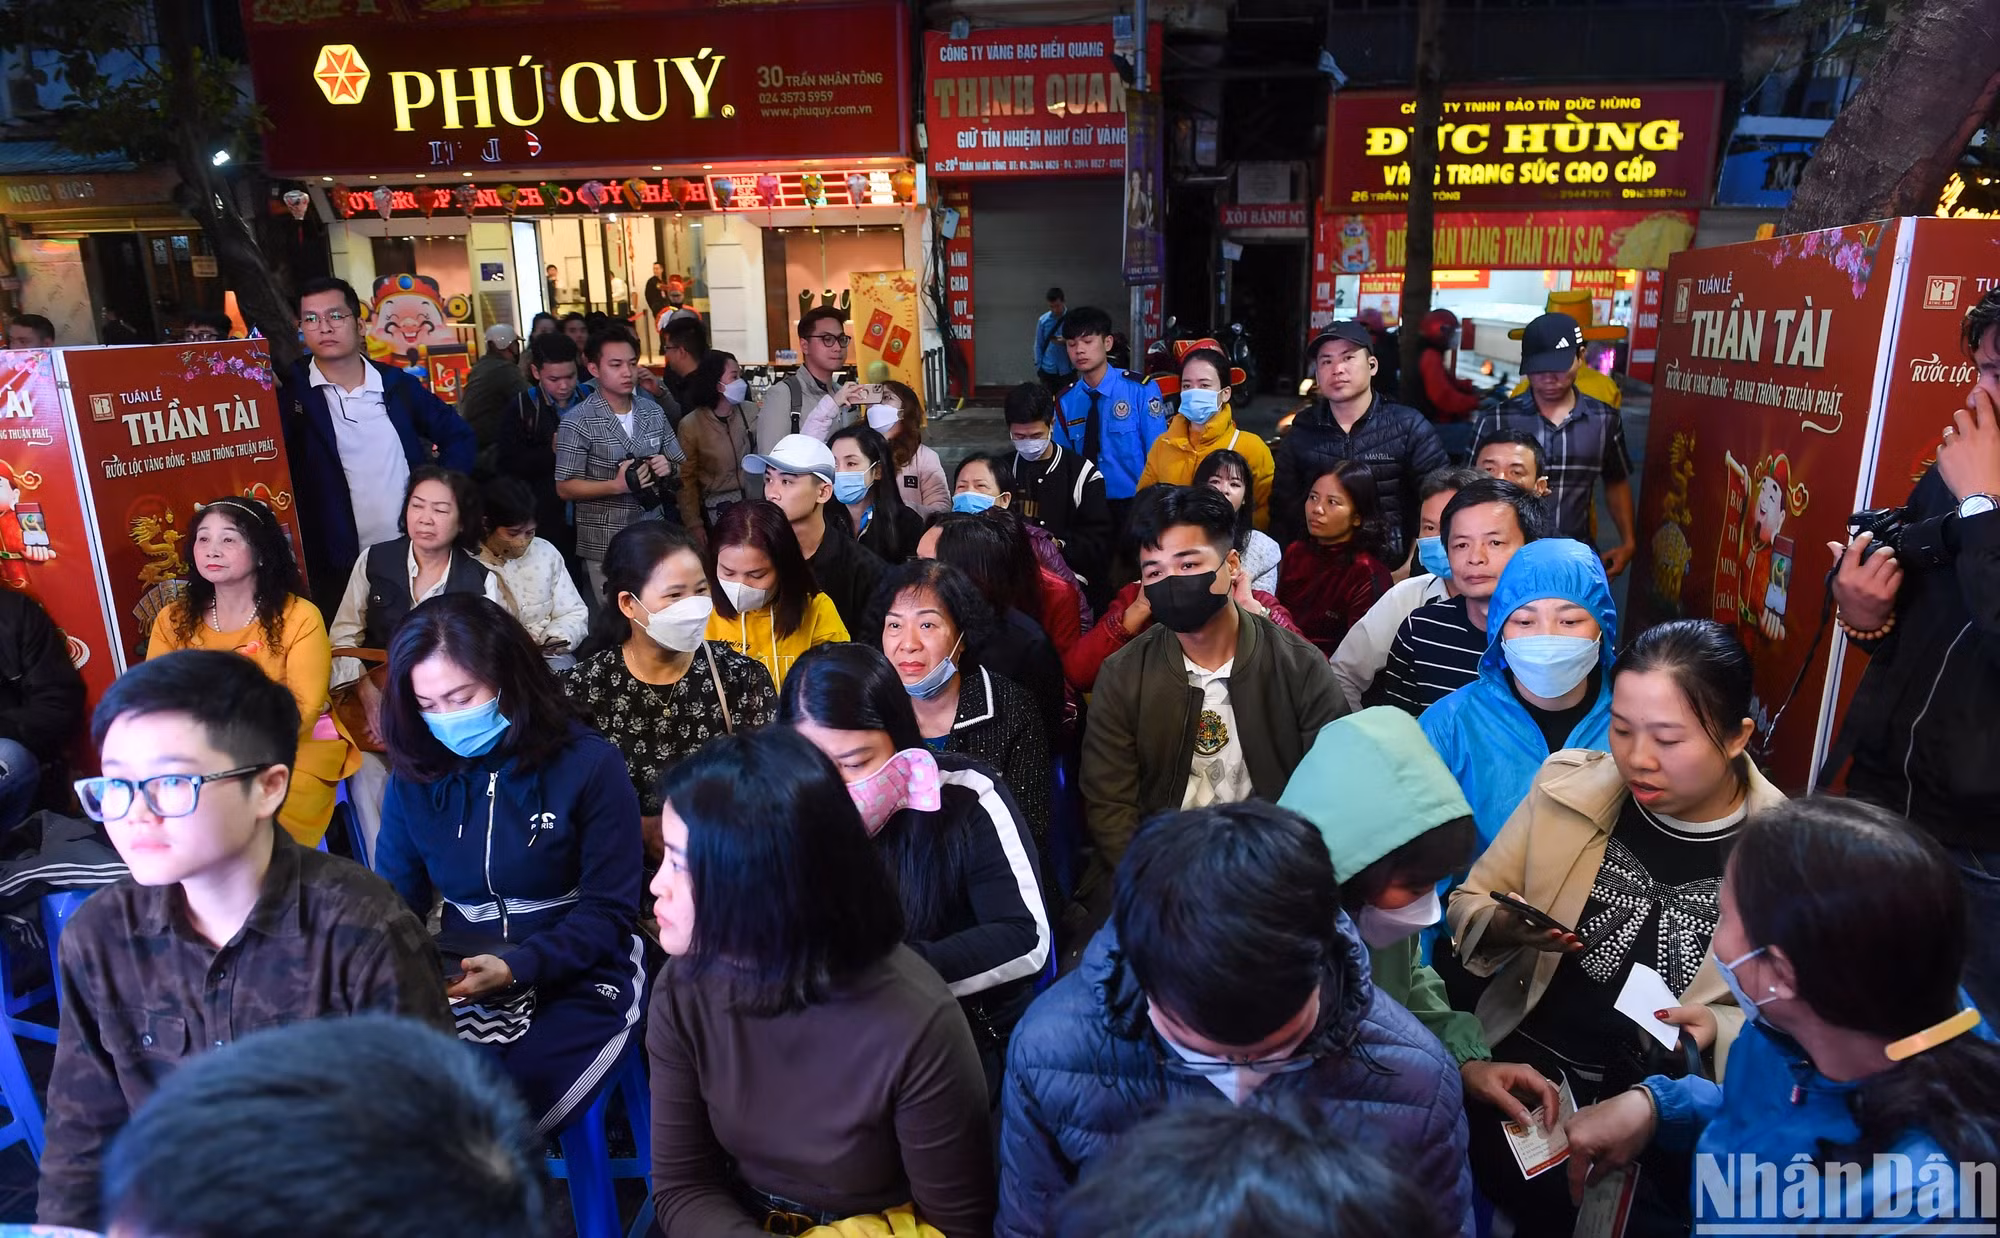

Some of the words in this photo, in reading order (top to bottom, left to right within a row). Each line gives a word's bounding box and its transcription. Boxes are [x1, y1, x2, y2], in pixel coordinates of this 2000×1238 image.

[939, 44, 968, 62] CÔNG
[970, 45, 983, 61] TY
[987, 41, 1013, 60] VÀNG
[1017, 44, 1038, 63] BẠC
[1068, 42, 1104, 58] QUANG
[757, 65, 784, 88] 30
[819, 71, 851, 86] NHÂN
[852, 70, 883, 85] TÔNG
[388, 55, 545, 131] PHÚ
[559, 48, 726, 124] QUÝ
[759, 92, 778, 104] 024
[780, 92, 806, 103] 3573
[808, 91, 833, 103] 5959
[933, 75, 1035, 124] THỊNH
[1045, 72, 1128, 119] QUAN
[761, 105, 872, 119] www.phuquy.com.vn
[1443, 102, 1460, 113] TY
[1464, 102, 1500, 112] TNHH
[1505, 97, 1535, 111] BẢO
[1537, 99, 1560, 111] TÍN
[1566, 97, 1595, 111] ĐỨC
[1600, 97, 1641, 109] HÙNG
[957, 127, 978, 148] GIỮ
[981, 127, 1000, 148] TÍN
[1003, 126, 1041, 151] NHIỆM
[1044, 127, 1070, 146] NHƯ
[1072, 123, 1094, 145] GIỮ
[1503, 112, 1684, 154] HÙNG
[1447, 163, 1514, 186] TRANG
[1564, 162, 1608, 184] CAO
[1614, 153, 1657, 182] CẤP
[1352, 191, 1368, 202] 26
[1433, 219, 1457, 265] ÁN
[1461, 218, 1500, 265] VÀNG
[1547, 217, 1570, 264] TÀI
[1573, 225, 1604, 265] SJC
[950, 248, 967, 267] KÍNH
[950, 273, 968, 291] CHÀO
[1976, 278, 2000, 293] TU
[954, 297, 967, 316] QUÝ
[1691, 293, 1767, 362] THẦN
[1774, 296, 1833, 367] TÀI
[1911, 357, 1945, 383] RƯỚC
[1949, 361, 1976, 388] LỘC
[0, 384, 34, 418] ÀI
[1755, 377, 1783, 408] THÔNG
[1783, 382, 1815, 416] THUẬN
[122, 398, 209, 446] THẦN
[214, 395, 260, 433] TÀI
[8, 426, 31, 441] THUẬN
[129, 458, 142, 478] LỘC
[144, 455, 164, 472] VÀNG
[212, 443, 234, 461] THÔNG
[235, 440, 257, 457] THUẬN
[531, 822, 554, 830] PRIS
